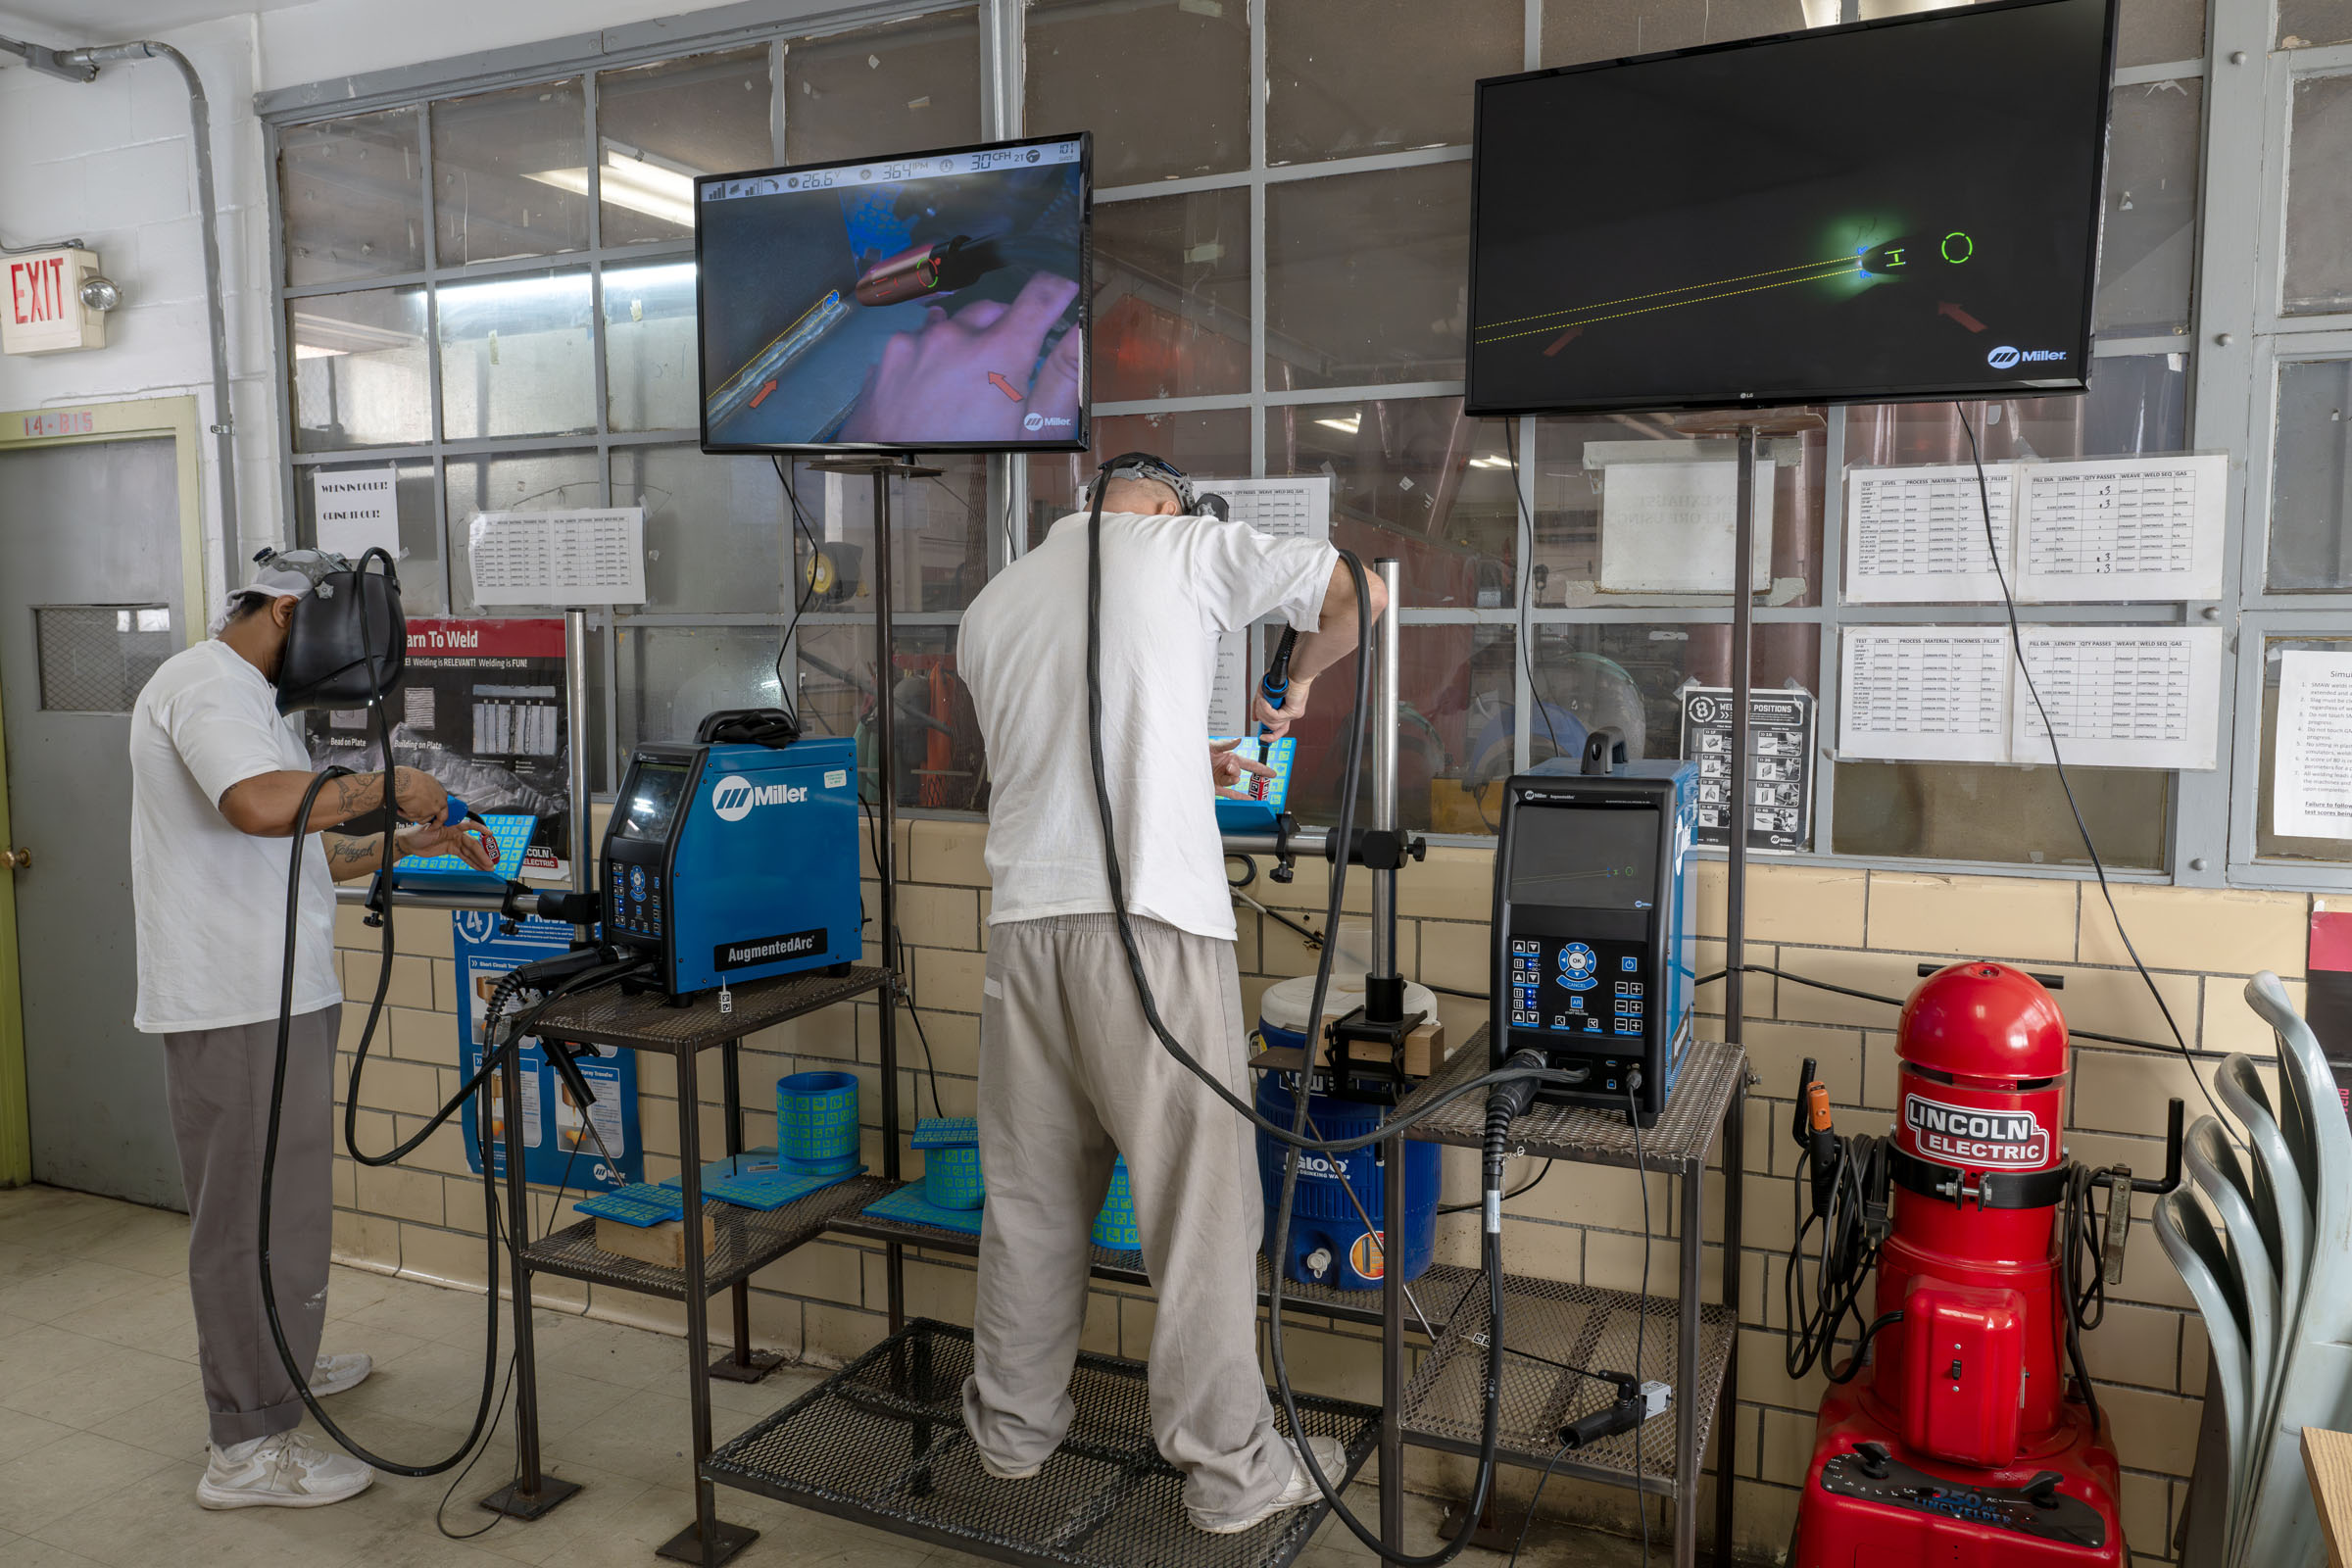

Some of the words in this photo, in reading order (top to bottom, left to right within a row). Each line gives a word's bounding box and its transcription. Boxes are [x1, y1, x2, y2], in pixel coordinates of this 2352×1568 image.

[970, 153, 991, 171] 30
[992, 152, 1010, 161] CFH
[803, 172, 833, 188] 26.6
[882, 164, 911, 180] 364
[11, 258, 64, 324] EXIT
[321, 484, 345, 493] WHEN
[407, 634, 426, 648] arn
[428, 631, 444, 648] To
[446, 630, 478, 648] Weld
[413, 658, 437, 668] Welding
[444, 659, 476, 667] RELEVANT!
[479, 659, 505, 669] Welding
[506, 659, 512, 667] is
[512, 659, 527, 667] FUN!
[1695, 702, 1708, 717] 8
[1754, 705, 1792, 713] POSITIONS
[394, 740, 417, 751] Building
[426, 741, 442, 750] Plate
[526, 849, 549, 858] COLN
[466, 911, 483, 933] 4
[728, 938, 813, 962] AugmentedArc
[1909, 1102, 2030, 1141] LINCOLN
[1930, 1137, 2040, 1160] ELECTRIC
[1300, 1169, 1328, 1178] DRINKING
[1932, 1487, 1982, 1508] 250
[1914, 1496, 2012, 1523] LINCWELDER
